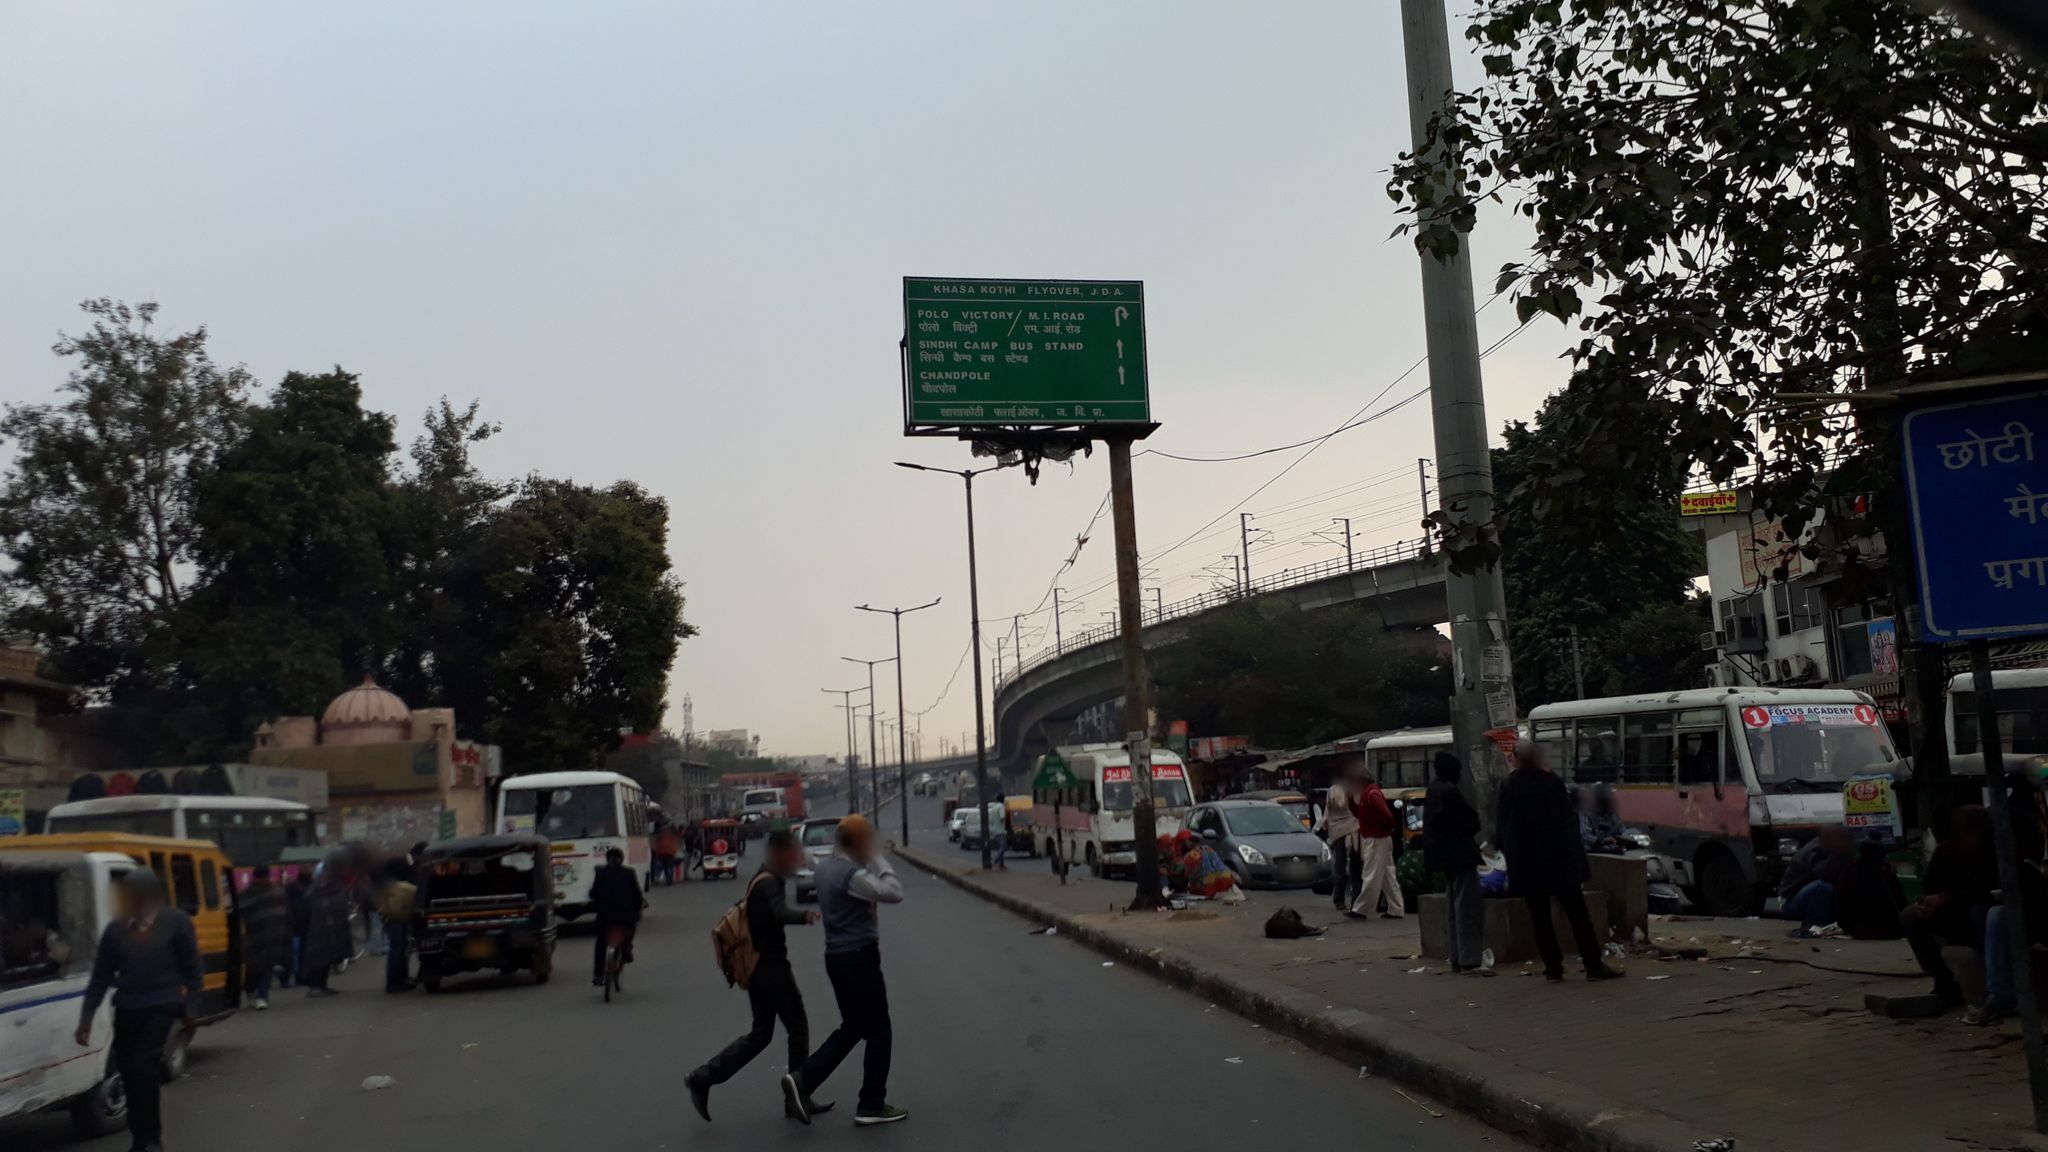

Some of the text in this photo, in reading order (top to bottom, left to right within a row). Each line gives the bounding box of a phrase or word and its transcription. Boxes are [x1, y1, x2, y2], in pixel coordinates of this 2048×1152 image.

[933, 285, 975, 294] KHASA
[980, 286, 1016, 295] KOTHI
[917, 309, 949, 319] POLO
[961, 311, 1014, 320] VICTORY
[1053, 312, 1085, 321] ROAD
[918, 320, 940, 332] पोलो
[919, 340, 1084, 351] SINDHI CAMP BUS STAND
[919, 371, 991, 381] CHANDPOLE
[1935, 420, 2035, 470] छोटी
[1768, 707, 1804, 716] FOCUS
[1807, 706, 1854, 715] ACADEMY
[1846, 815, 1868, 826] RAS
